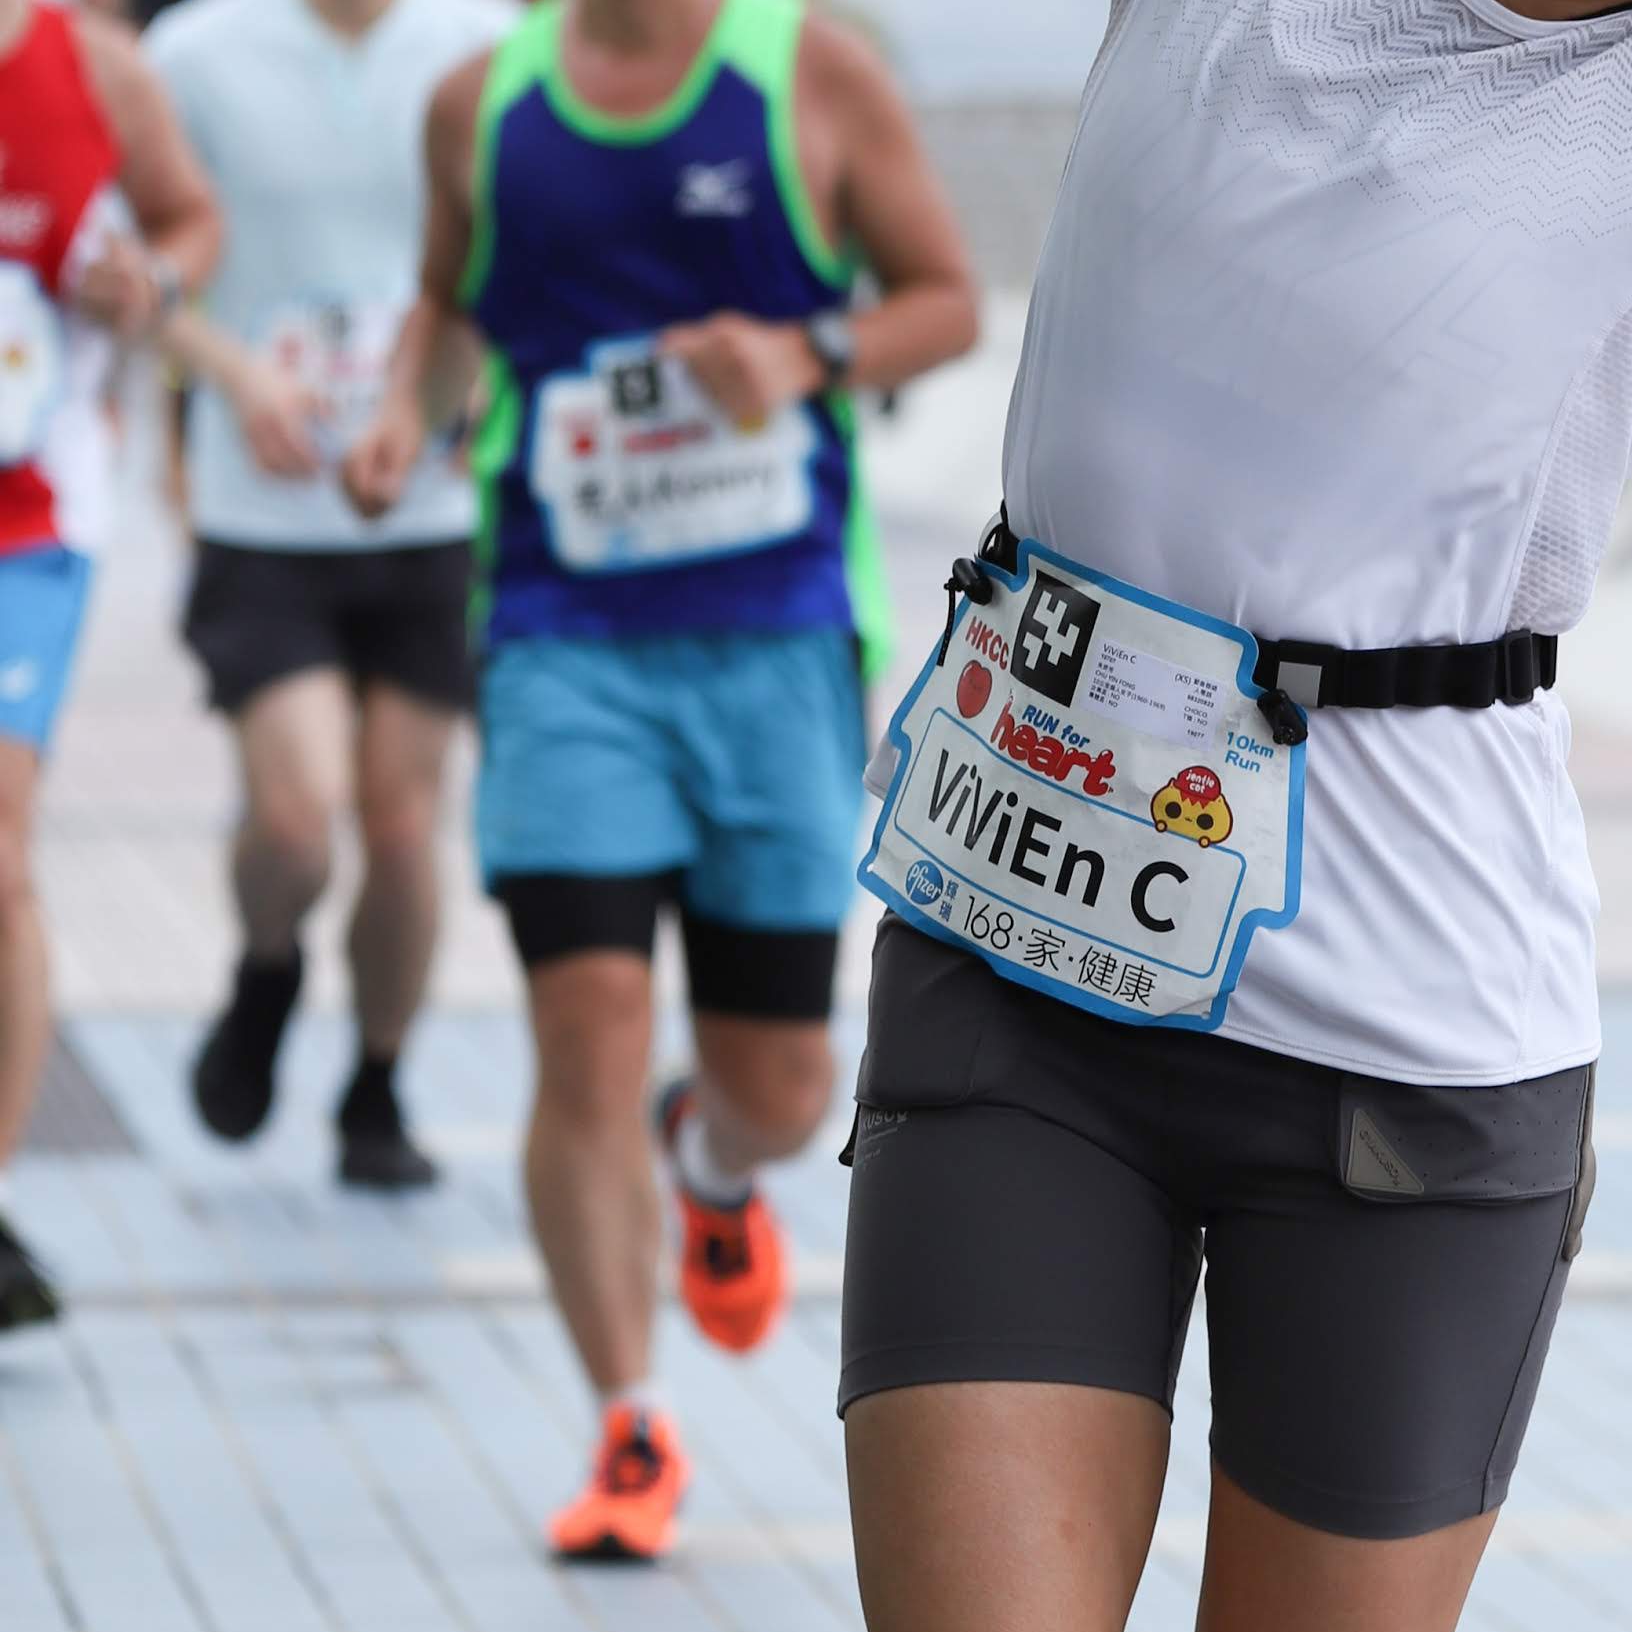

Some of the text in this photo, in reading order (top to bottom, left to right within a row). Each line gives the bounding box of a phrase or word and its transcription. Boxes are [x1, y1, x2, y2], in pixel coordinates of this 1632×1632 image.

[965, 616, 1009, 670] HKCC
[1130, 655, 1137, 664] C
[990, 691, 1116, 797] heart
[1021, 704, 1090, 748] RUN for
[1226, 731, 1275, 759] 10km
[1225, 750, 1261, 773] Run
[928, 748, 1190, 933] ViViEn C
